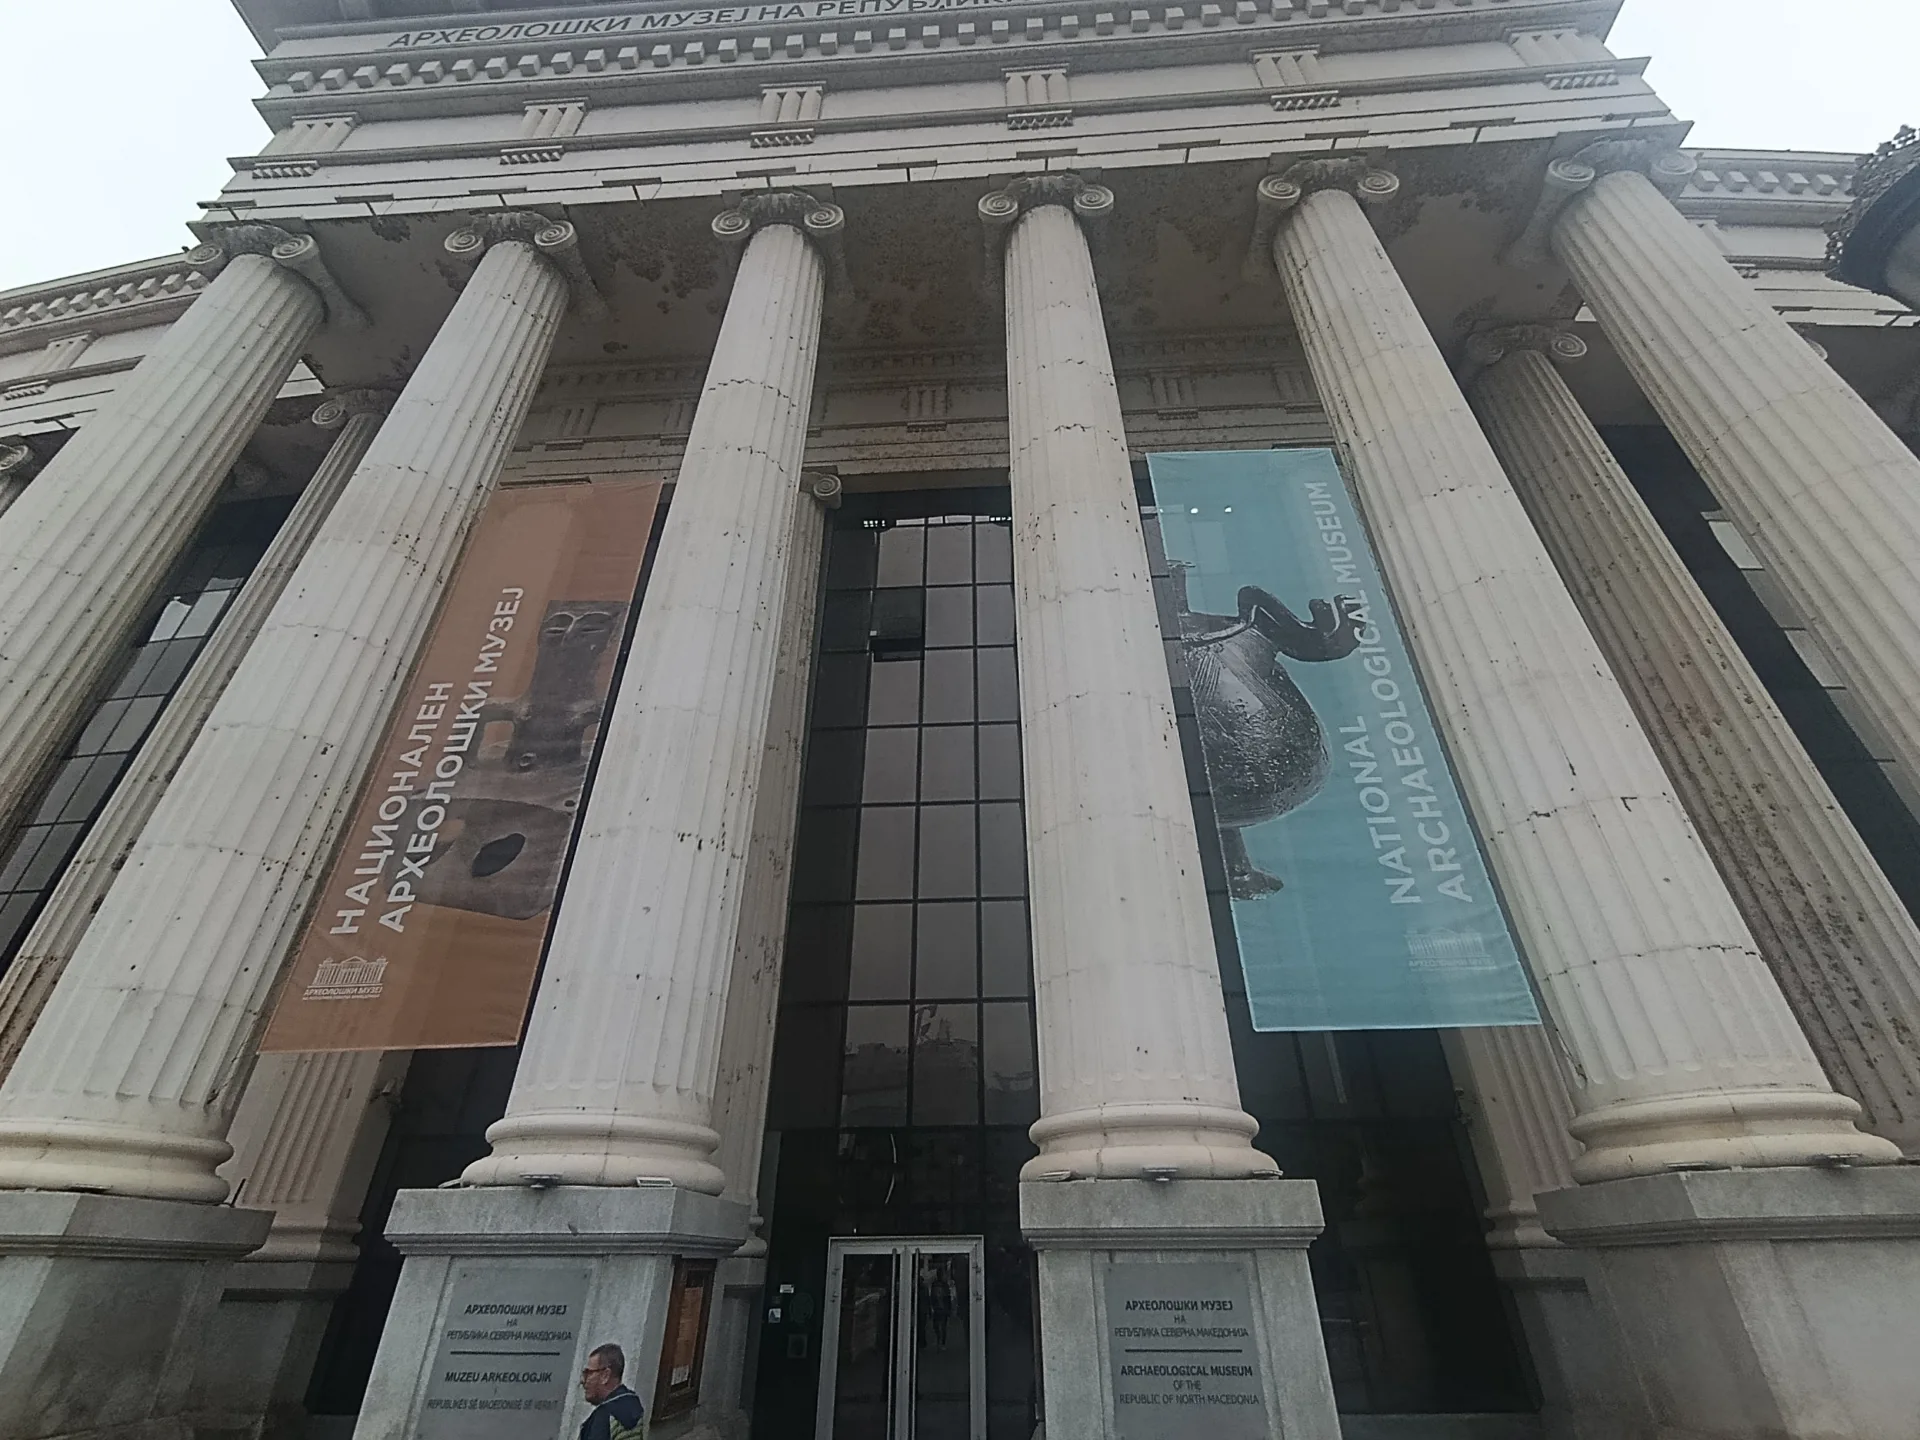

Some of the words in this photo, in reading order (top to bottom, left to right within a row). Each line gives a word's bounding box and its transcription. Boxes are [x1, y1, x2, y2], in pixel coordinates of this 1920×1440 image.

[388, 16, 633, 48] АРХЕОЛОШКИ
[641, 8, 750, 29] МУЗЕЈ
[758, 4, 806, 20] НА
[816, 0, 1013, 16] РЕПУБЛ
[1304, 481, 1361, 584] MUSEUM
[1341, 589, 1473, 903] ARCHAEOLOGICAL
[378, 679, 493, 933] АРХЕОЛОШКИ
[473, 586, 524, 673] МУЗЕЈ
[330, 681, 454, 935] НАЦИОНАЛЕН
[1339, 715, 1421, 904] NATIONAL
[464, 1304, 534, 1315] АРХЕОЛОШКИ
[535, 1304, 567, 1315] МУЗЕЈ
[1125, 1300, 1198, 1311] АРХЕОЛОШКИ
[1201, 1300, 1233, 1311] МУЗЕЈ
[1174, 1314, 1186, 1323] НА
[1114, 1327, 1160, 1338] РЕПУБЛИКА
[1160, 1327, 1195, 1338] СЕВЕРНА
[1120, 1365, 1208, 1376] ARCHAEOLOGICAL
[1210, 1365, 1253, 1376] MUSEUM
[445, 1371, 480, 1383] MUZEU
[480, 1371, 552, 1383] ARKEOLOGJIK
[1173, 1380, 1185, 1390] OF
[1186, 1380, 1202, 1390] THE
[1119, 1394, 1161, 1405] REPUBLIC
[1162, 1394, 1175, 1405] OF
[1175, 1394, 1205, 1405] NORTH
[1206, 1394, 1260, 1405] MACEDONIA
